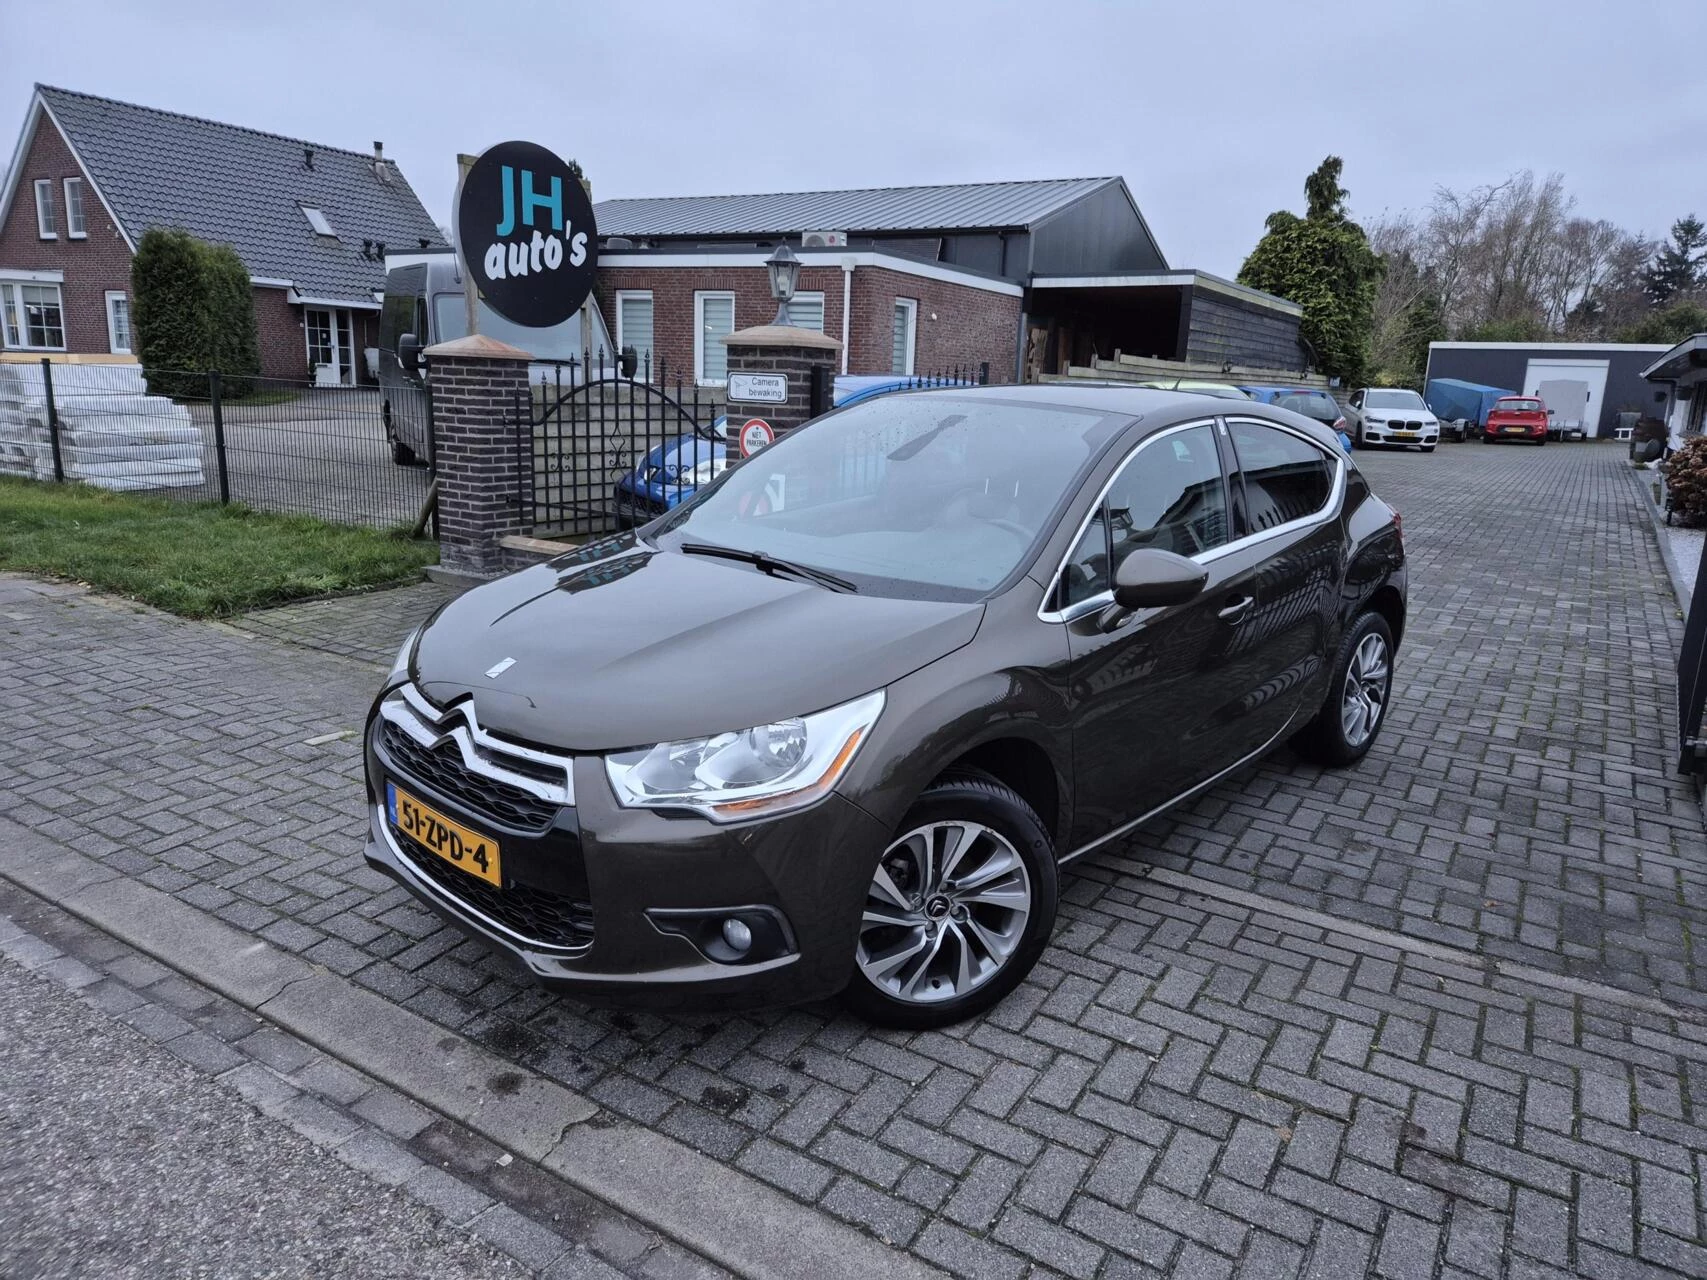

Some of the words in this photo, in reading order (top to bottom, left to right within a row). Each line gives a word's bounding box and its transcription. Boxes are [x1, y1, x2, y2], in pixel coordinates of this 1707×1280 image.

[496, 165, 563, 237] JH
[484, 219, 588, 280] auto's
[748, 388, 782, 399] bewaking
[751, 377, 779, 387] Camera
[402, 800, 489, 874] 51-ZPD-4
